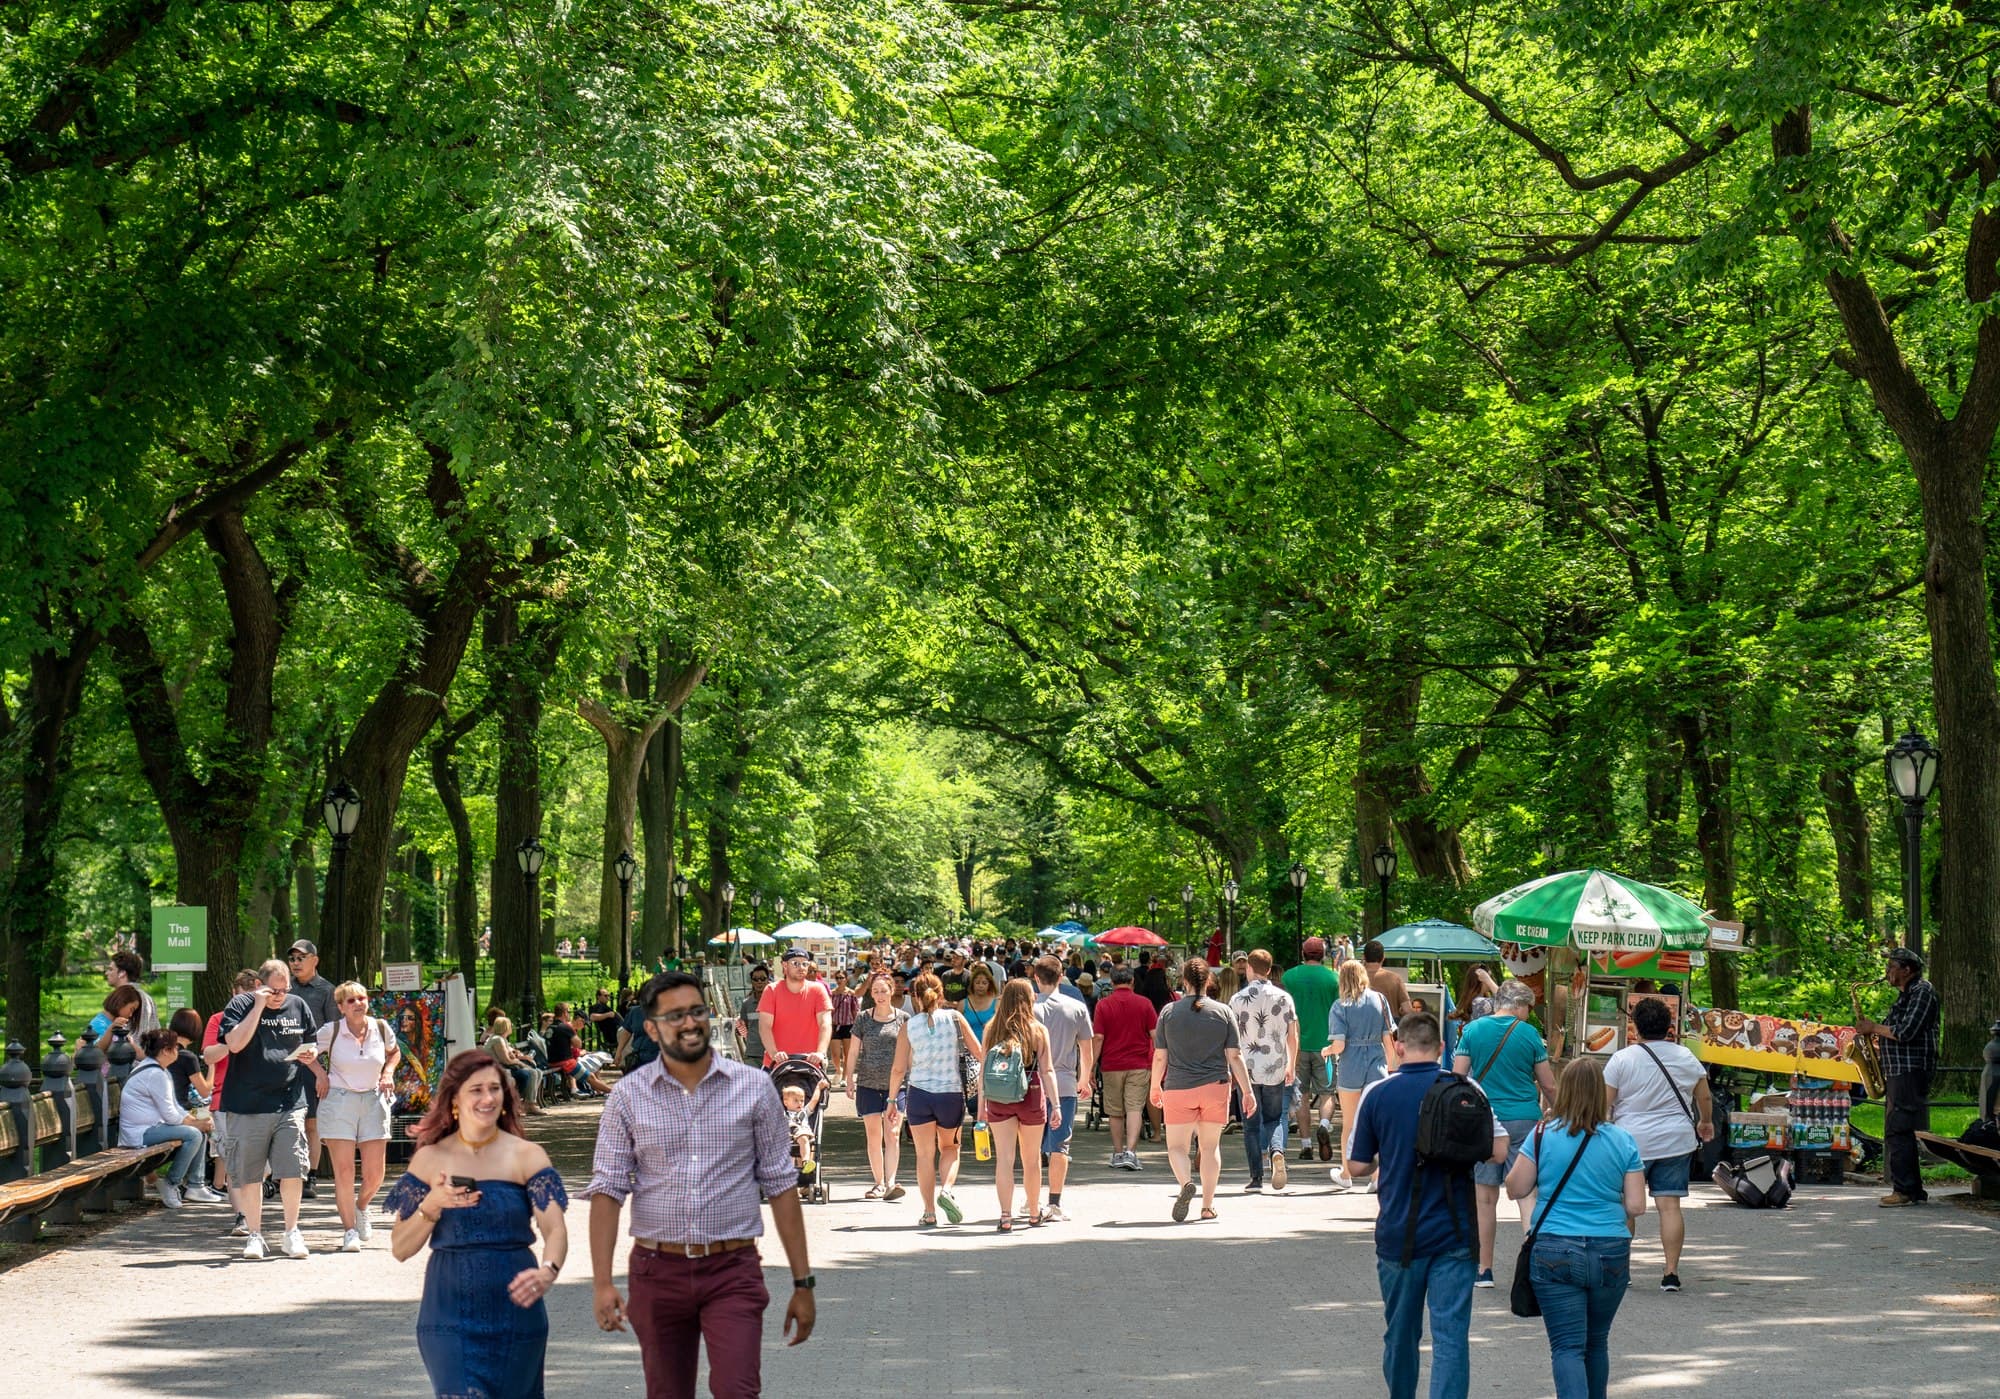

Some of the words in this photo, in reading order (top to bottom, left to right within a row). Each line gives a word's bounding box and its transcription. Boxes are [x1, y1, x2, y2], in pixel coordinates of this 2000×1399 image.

[168, 923, 190, 934] The
[1516, 924, 1527, 937] ICE
[1527, 925, 1549, 939] CREAM
[167, 936, 191, 947] Mall
[1577, 930, 1599, 945] KEEP
[1601, 931, 1625, 946] PARK
[1627, 932, 1656, 947] CLEAN
